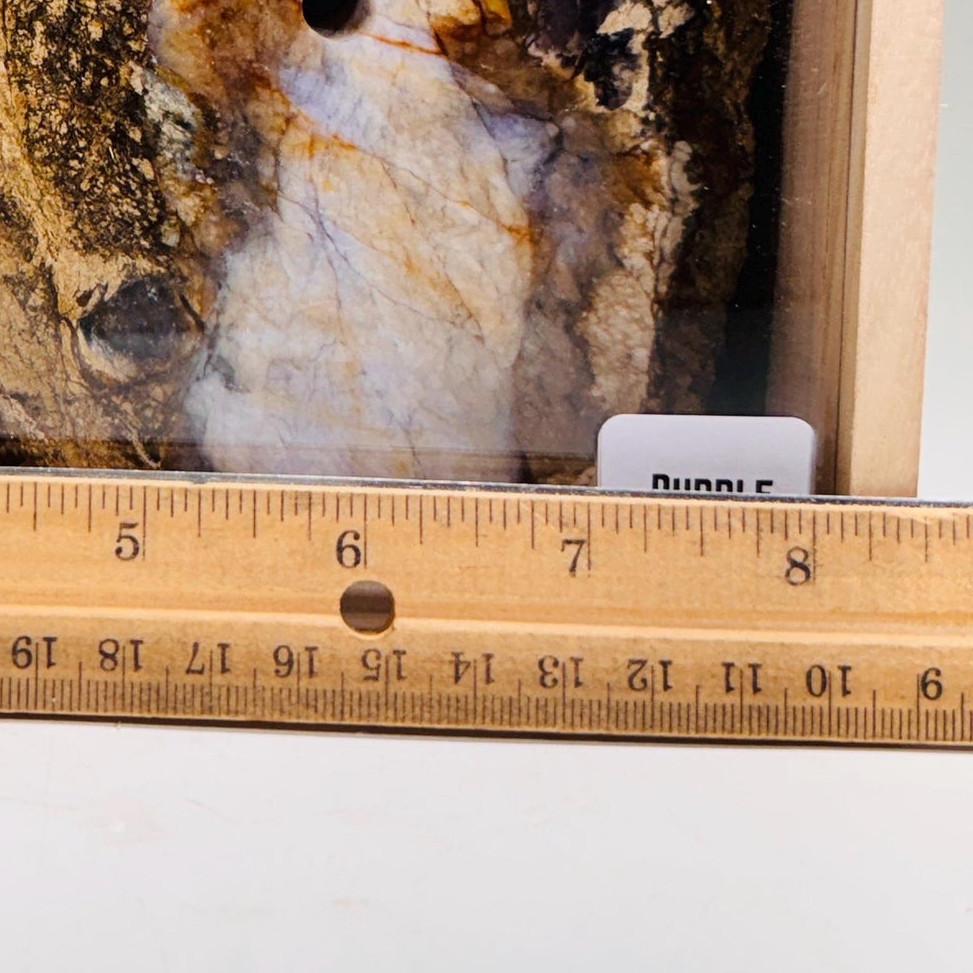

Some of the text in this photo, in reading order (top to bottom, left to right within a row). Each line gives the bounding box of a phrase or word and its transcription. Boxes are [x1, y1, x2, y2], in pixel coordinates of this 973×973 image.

[115, 522, 140, 561] 5
[335, 530, 362, 569] 6
[562, 538, 587, 577] 7
[784, 546, 811, 586] 8
